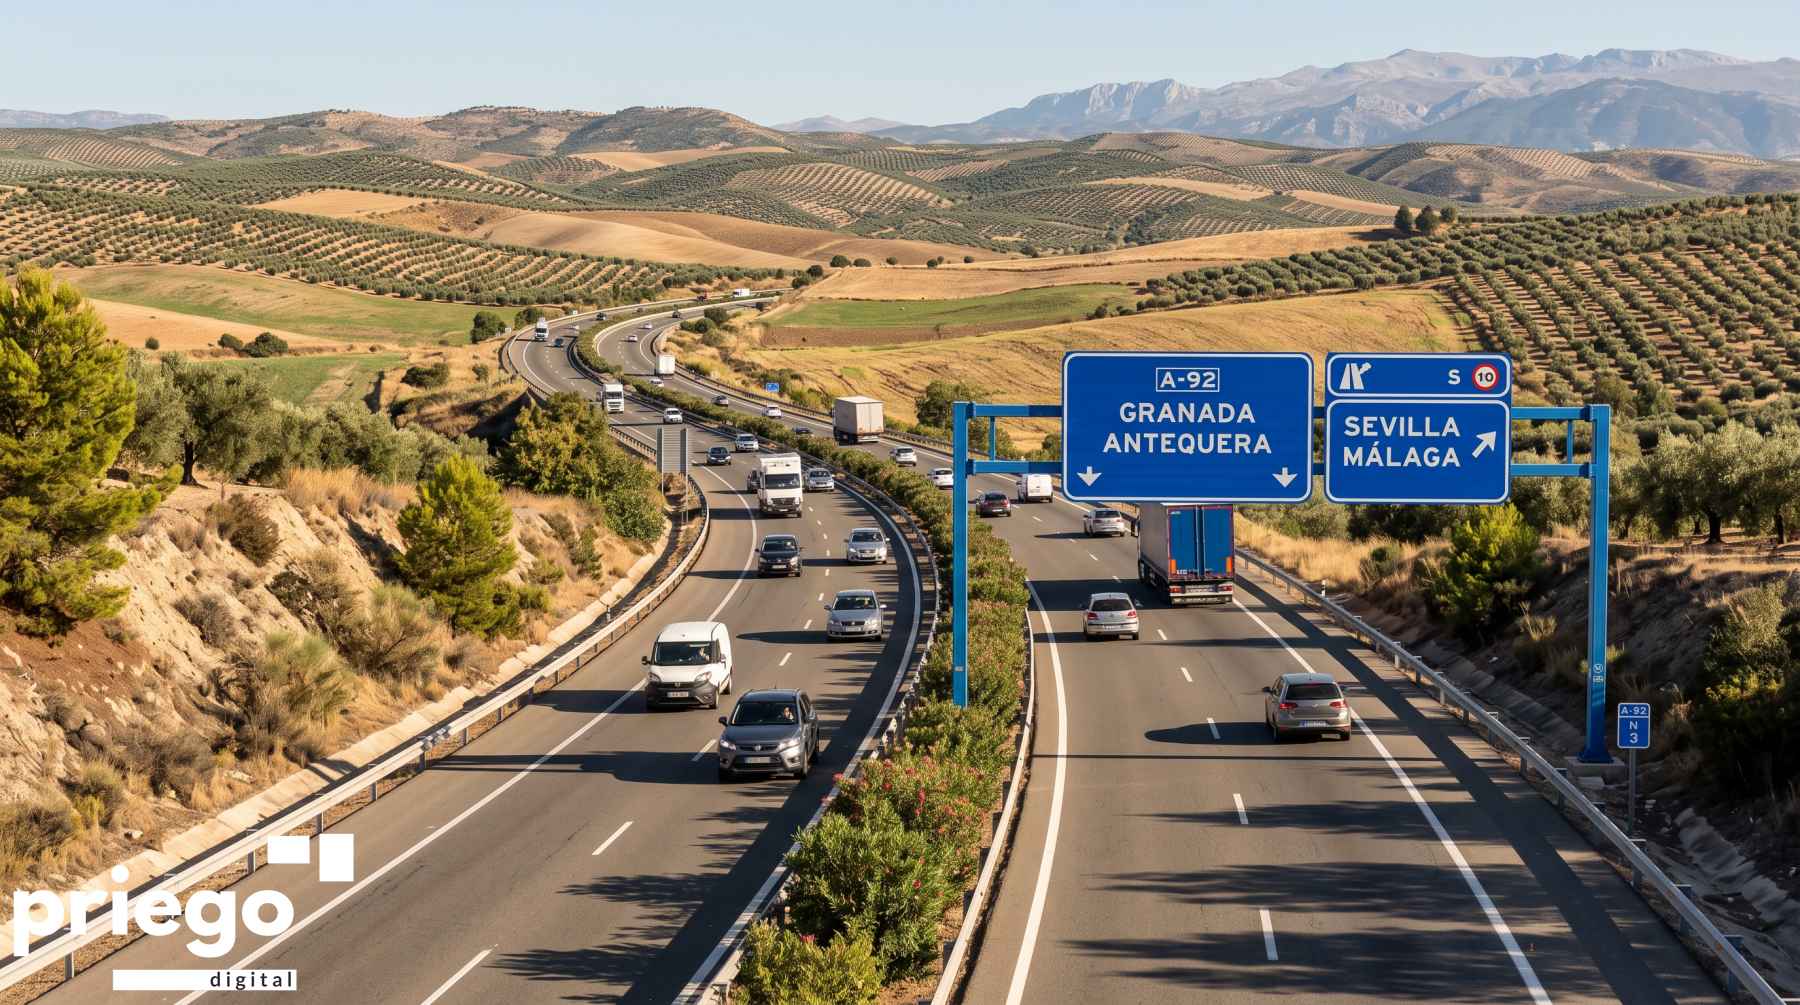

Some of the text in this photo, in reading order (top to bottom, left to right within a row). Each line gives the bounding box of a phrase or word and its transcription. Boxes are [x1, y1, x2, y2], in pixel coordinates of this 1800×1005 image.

[1159, 371, 1216, 389] A-92
[1447, 368, 1494, 386] S 10
[1119, 402, 1256, 423] GRANADA
[1343, 415, 1460, 437] SEVILLA
[1103, 432, 1272, 455] ANTEQUERA
[1343, 440, 1460, 468] MÁLAGA
[1620, 706, 1648, 715] A-92
[1629, 720, 1638, 730] N
[1629, 732, 1639, 744] 3
